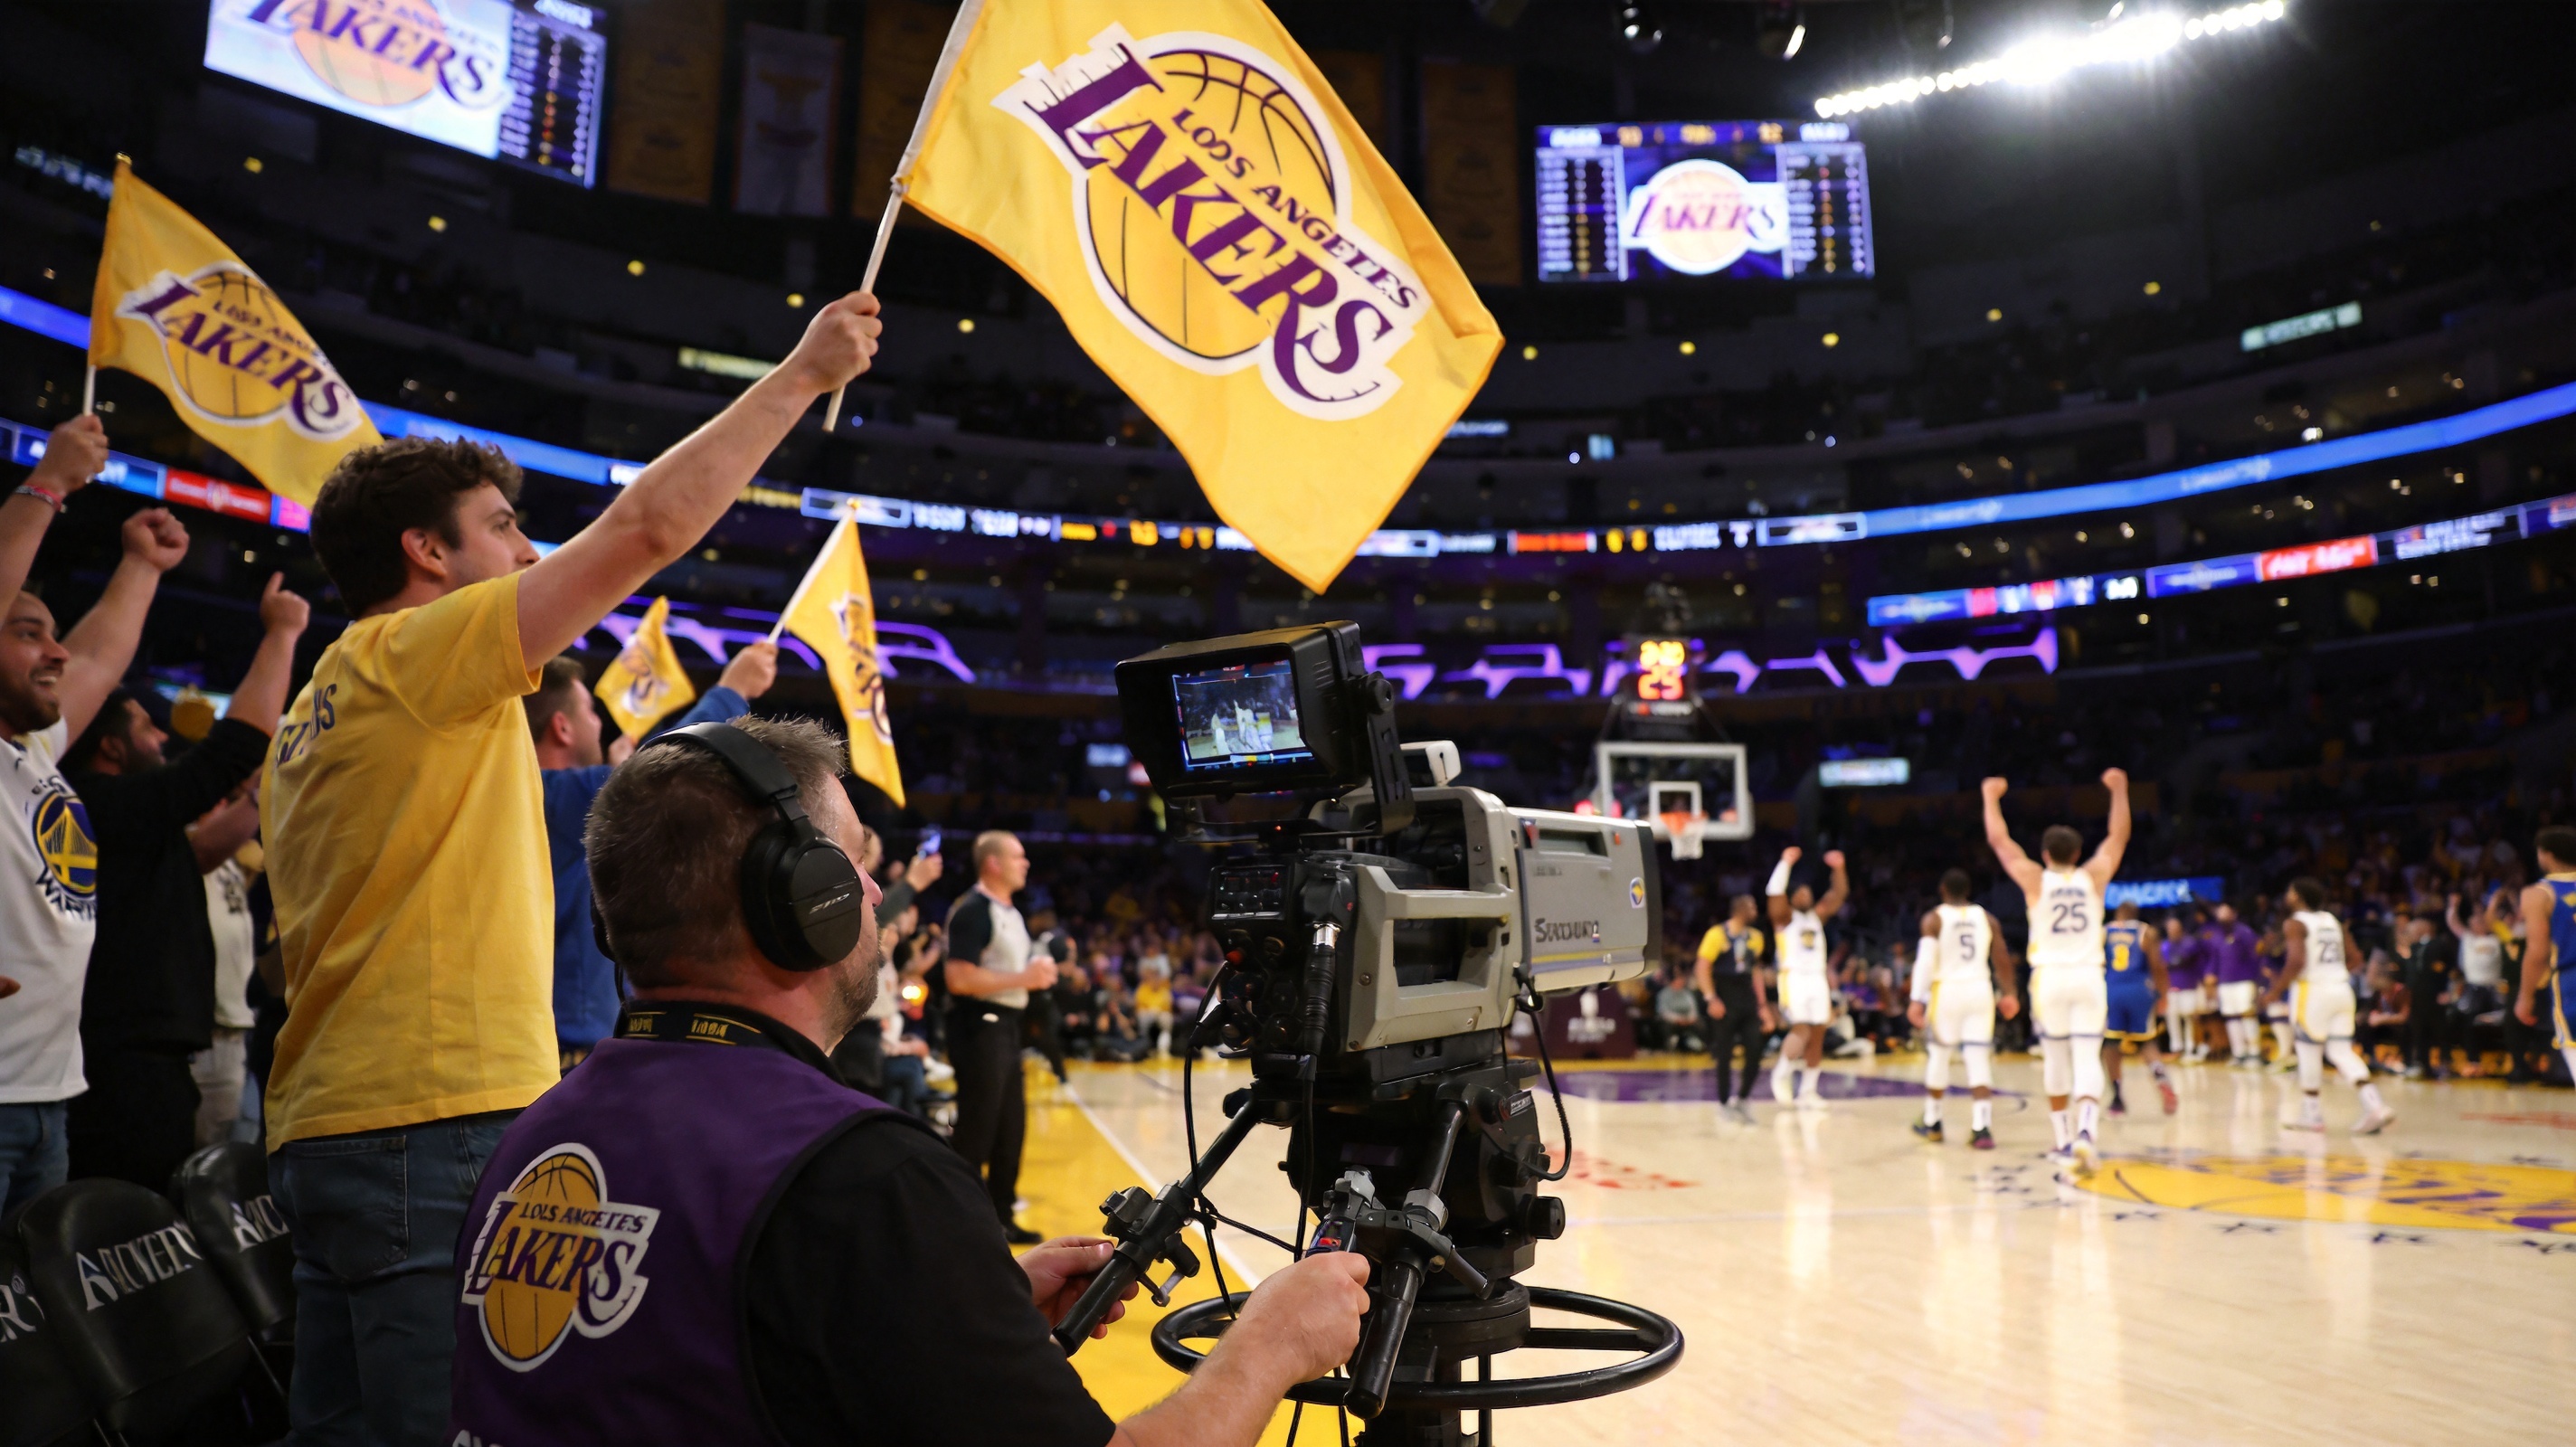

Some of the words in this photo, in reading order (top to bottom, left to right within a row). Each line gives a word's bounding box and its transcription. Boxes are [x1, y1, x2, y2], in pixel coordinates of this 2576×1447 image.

[1024, 43, 1394, 402] LAKERS
[1631, 193, 1776, 241] LAKERS
[128, 279, 353, 432] LAKERS
[1959, 933, 1976, 961] 5
[2051, 903, 2088, 933] 25
[465, 1200, 637, 1326] LAKERS
